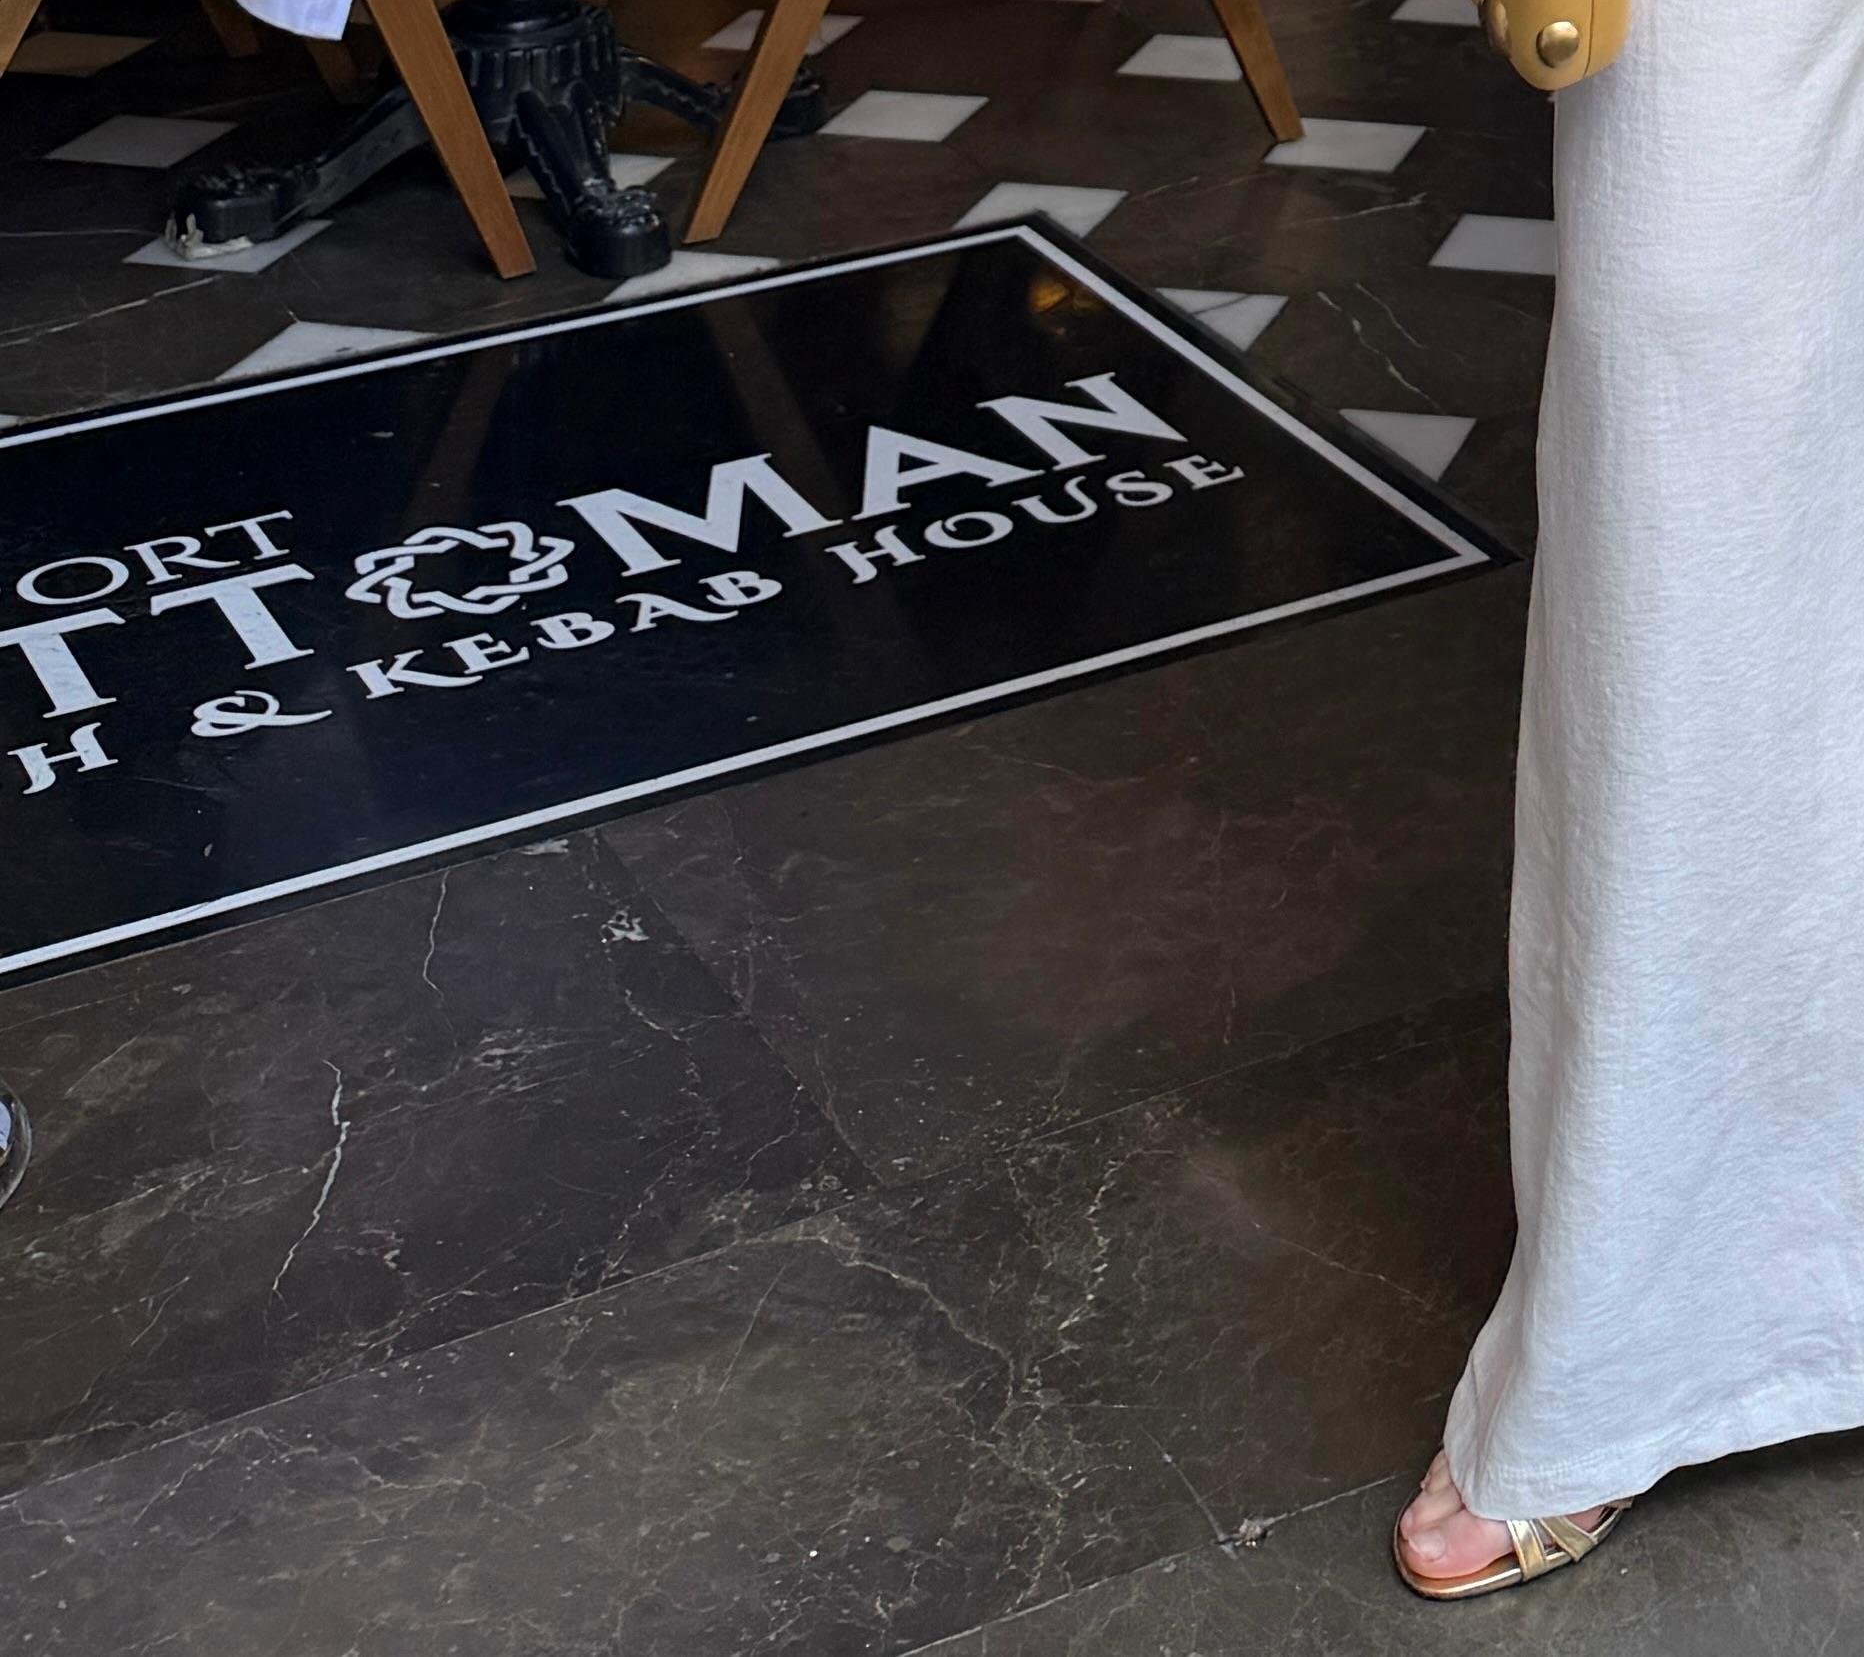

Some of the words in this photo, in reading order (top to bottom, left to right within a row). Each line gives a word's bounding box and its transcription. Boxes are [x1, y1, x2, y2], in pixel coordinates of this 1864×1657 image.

[190, 690, 332, 737] &
[345, 569, 783, 700] KEBAB
[825, 454, 1246, 585] HOUSE
